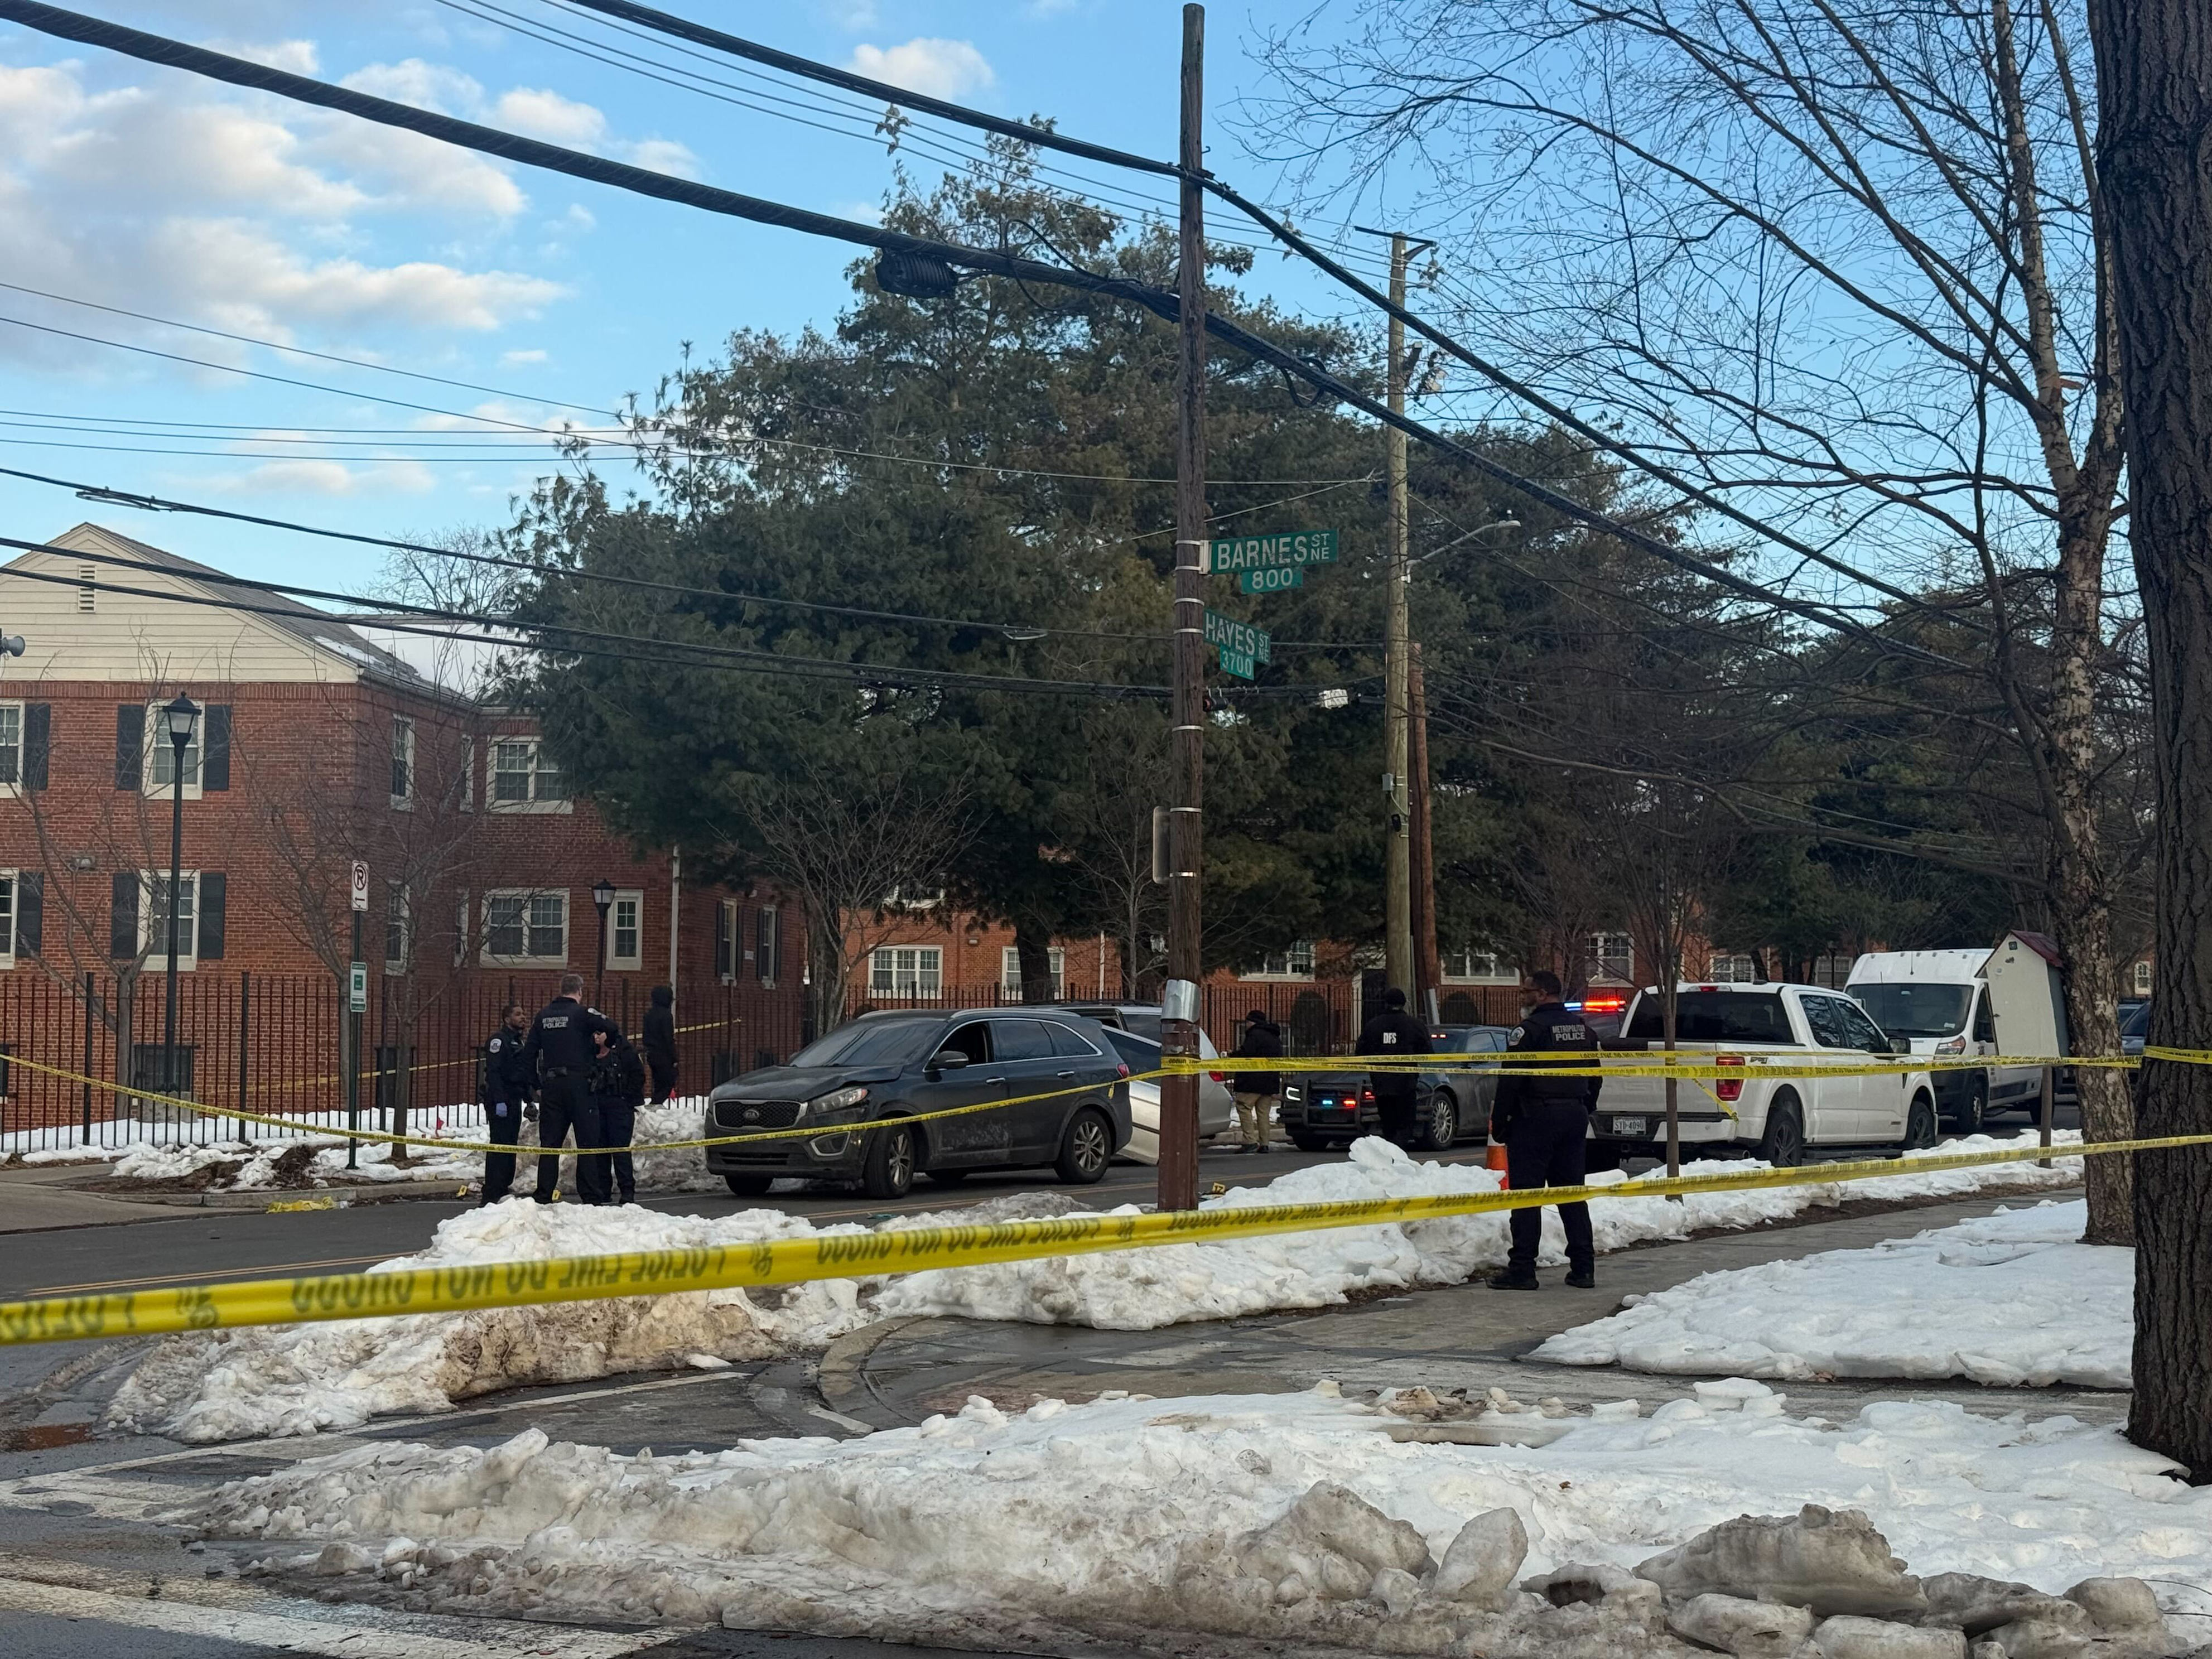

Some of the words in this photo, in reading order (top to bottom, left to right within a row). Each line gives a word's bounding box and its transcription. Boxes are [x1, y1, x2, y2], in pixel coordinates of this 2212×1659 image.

[1218, 536, 1307, 570] BARNES
[1311, 533, 1330, 548] ST
[1311, 547, 1329, 561] NE
[1251, 568, 1293, 590] 800
[1205, 613, 1255, 656] HAYES
[1259, 633, 1270, 648] ST
[1222, 650, 1253, 677] 3700
[1258, 647, 1269, 663] NE
[1383, 1032, 1397, 1044] DFS
[1555, 1032, 1585, 1041] POLICE
